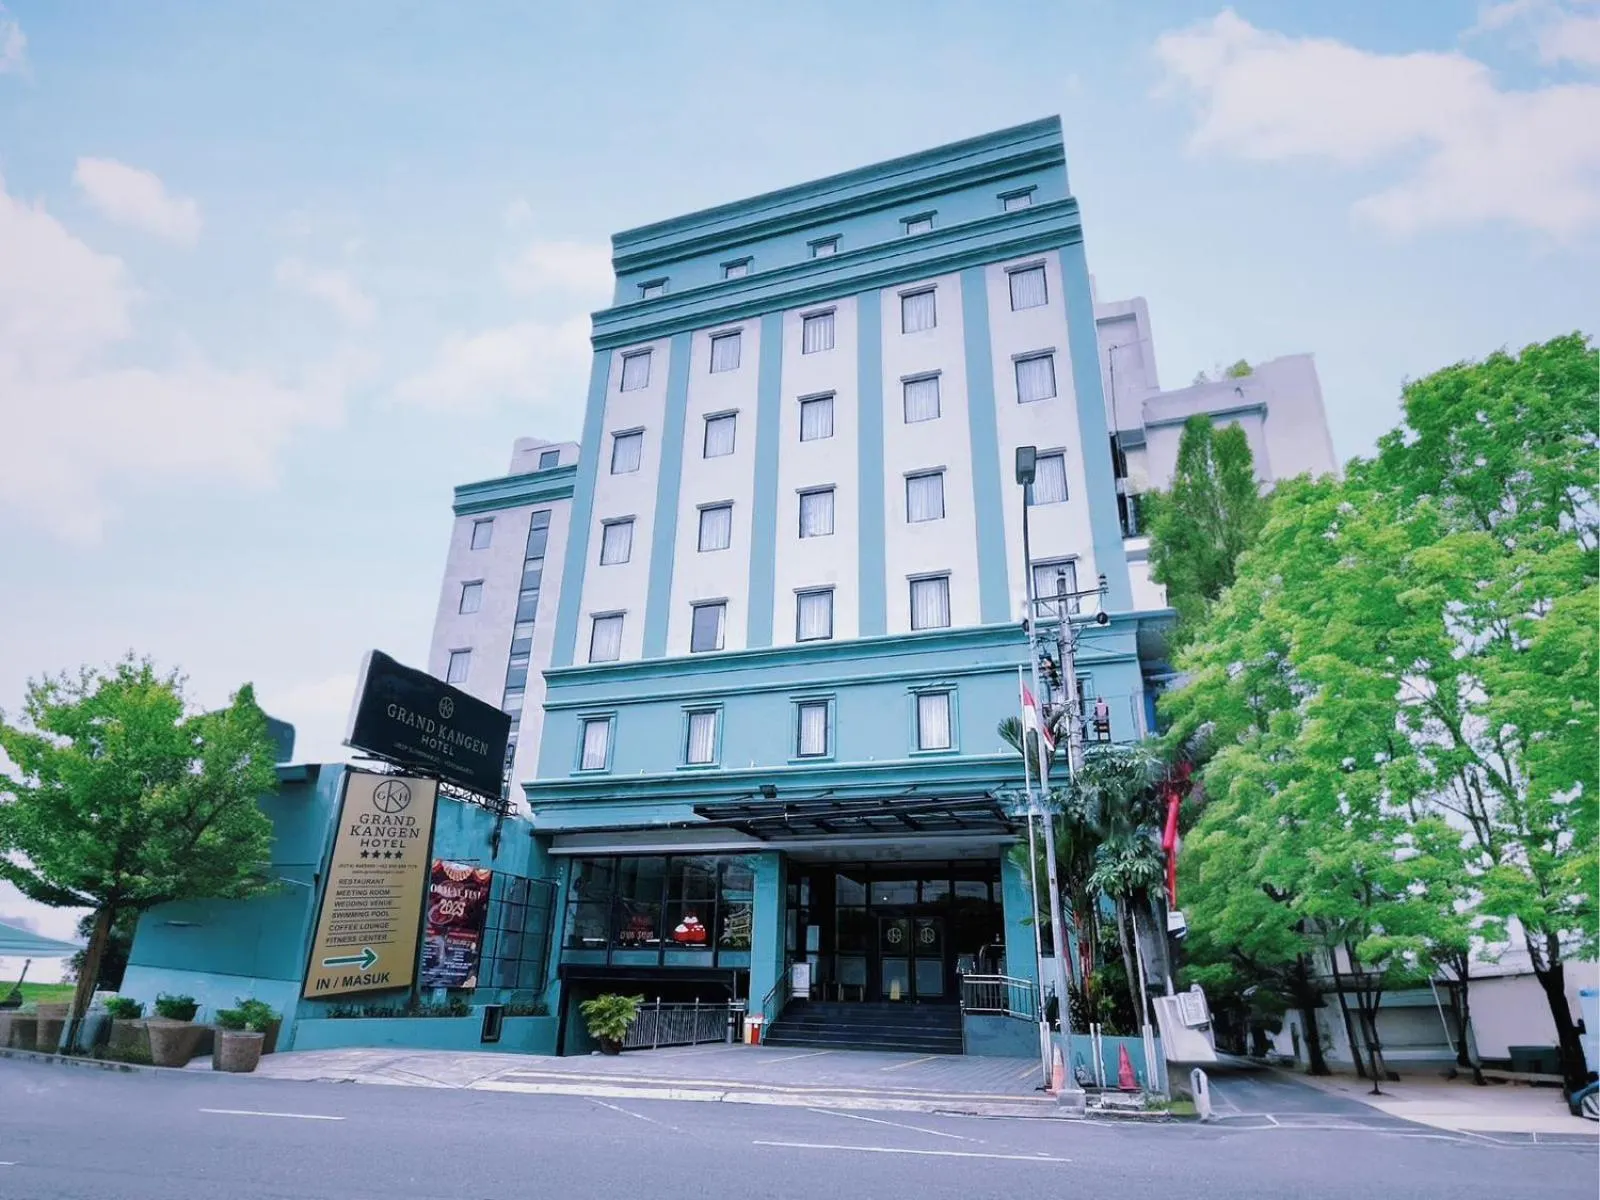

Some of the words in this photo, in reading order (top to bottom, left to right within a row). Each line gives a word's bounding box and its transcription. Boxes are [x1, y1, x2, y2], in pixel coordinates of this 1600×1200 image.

[387, 703, 435, 733] GRAND
[438, 724, 489, 756] KANGEN
[421, 734, 454, 756] HOTEL
[359, 813, 416, 826] GRAND
[350, 825, 420, 838] KANGEN
[360, 838, 406, 848] HOTEL
[331, 911, 370, 919] SWIMMING
[328, 923, 358, 931] COFFEE
[359, 922, 390, 930] LOUNGE
[325, 935, 357, 944] FITNESS
[358, 934, 388, 942] CENTER
[316, 977, 331, 990] IN
[333, 976, 339, 989] /
[341, 972, 390, 987] MASUK
